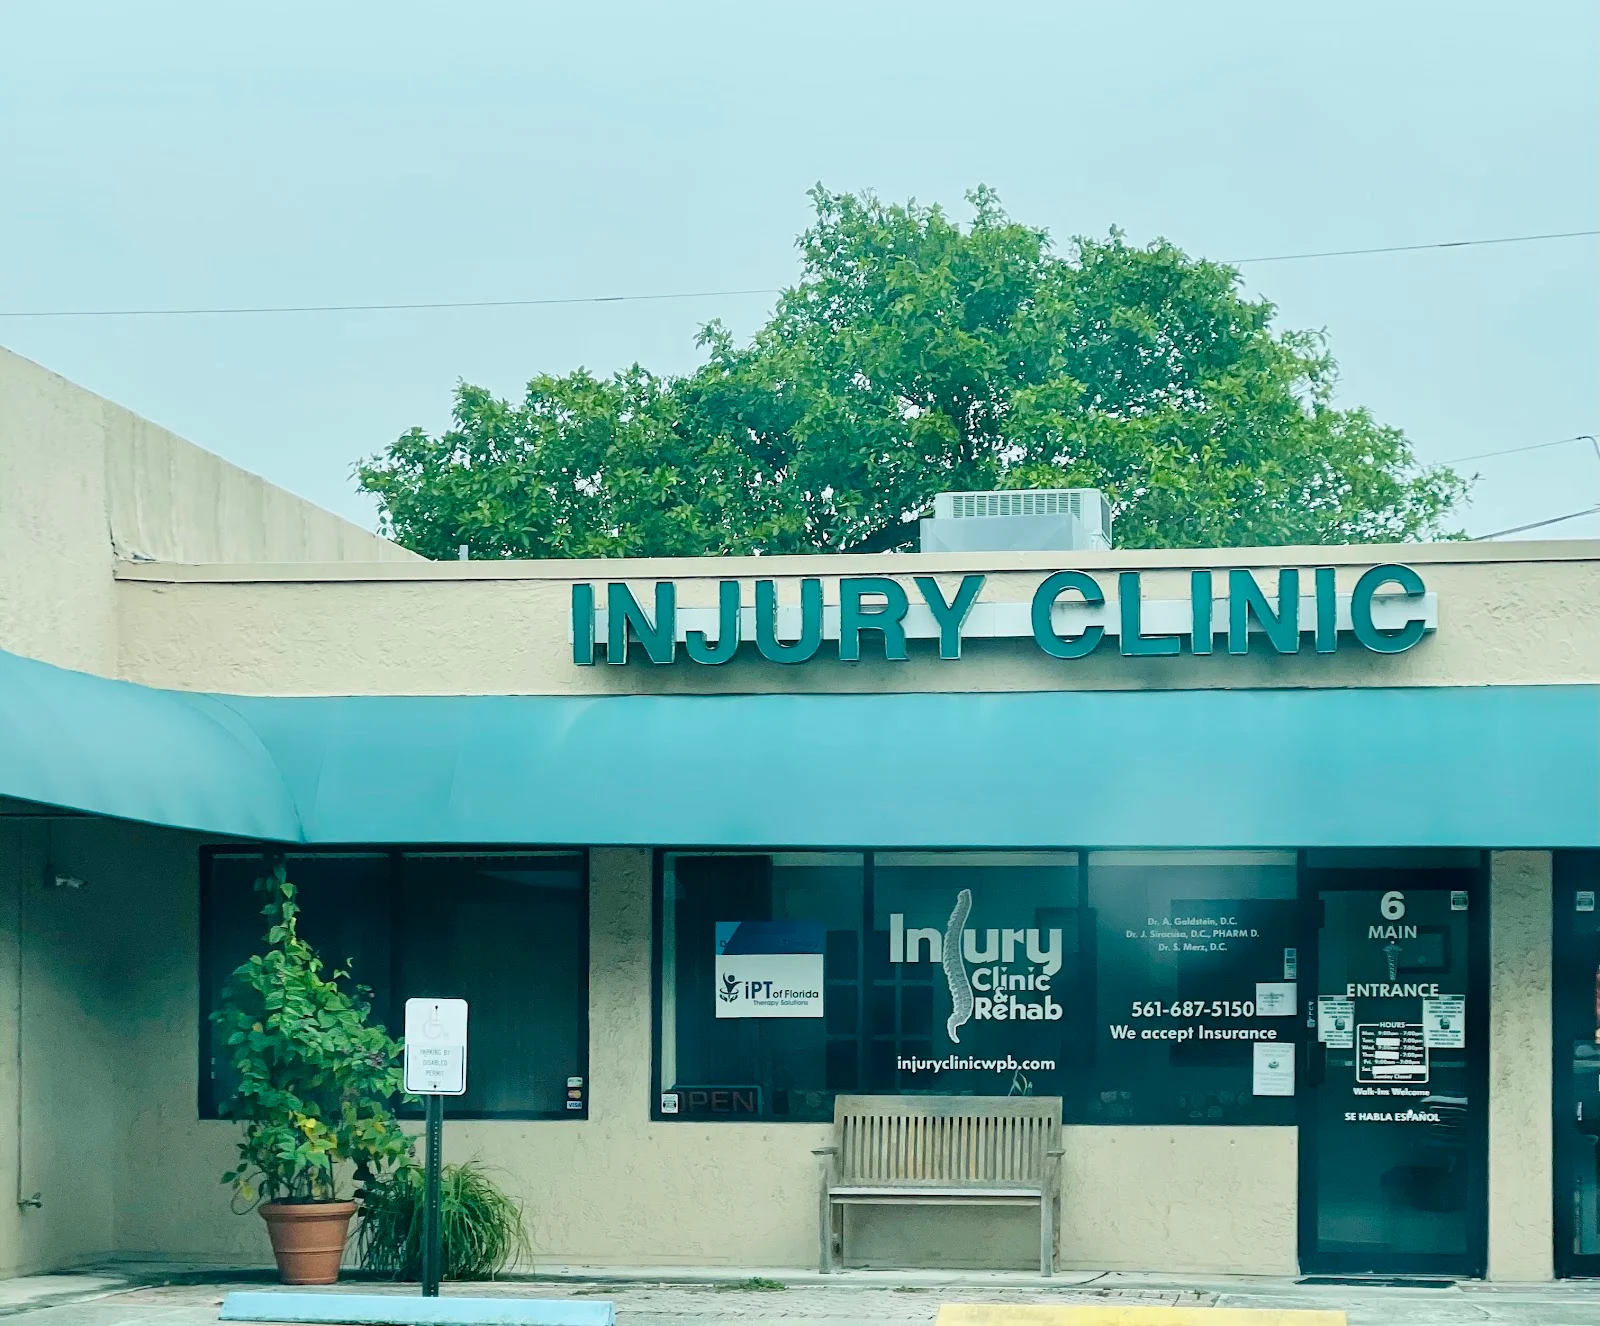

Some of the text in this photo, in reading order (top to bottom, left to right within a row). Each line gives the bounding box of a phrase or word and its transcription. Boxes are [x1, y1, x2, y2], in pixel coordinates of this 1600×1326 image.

[571, 562, 1427, 666] INJURY CLINIC
[1380, 890, 1406, 921] 6
[1147, 916, 1238, 927] Dr. A. Goldstein, D.C.
[1126, 930, 1138, 938] Dr.
[1140, 930, 1147, 938] J.
[1150, 930, 1189, 939] Siracusa,
[1212, 929, 1248, 938] PHARM
[1250, 929, 1260, 938] D.
[1368, 925, 1418, 939] MAIN
[1158, 942, 1228, 953] Dr. S. Merz, D.C.
[971, 966, 1051, 992] Clinic
[745, 981, 819, 1000] iPT of Florida
[993, 986, 1009, 1004] &
[1346, 983, 1439, 998] ENTRANCE
[974, 995, 1063, 1021] Rehab
[1131, 1001, 1255, 1018] 561-687-5150
[1109, 1024, 1278, 1043] We accept Insurance
[1380, 1021, 1406, 1029] HOURS
[897, 1055, 1056, 1073] injuryclinicwpb.com
[1391, 1087, 1430, 1096] Welcome
[1344, 1110, 1441, 1122] SE HABLA ESPAÑOL
